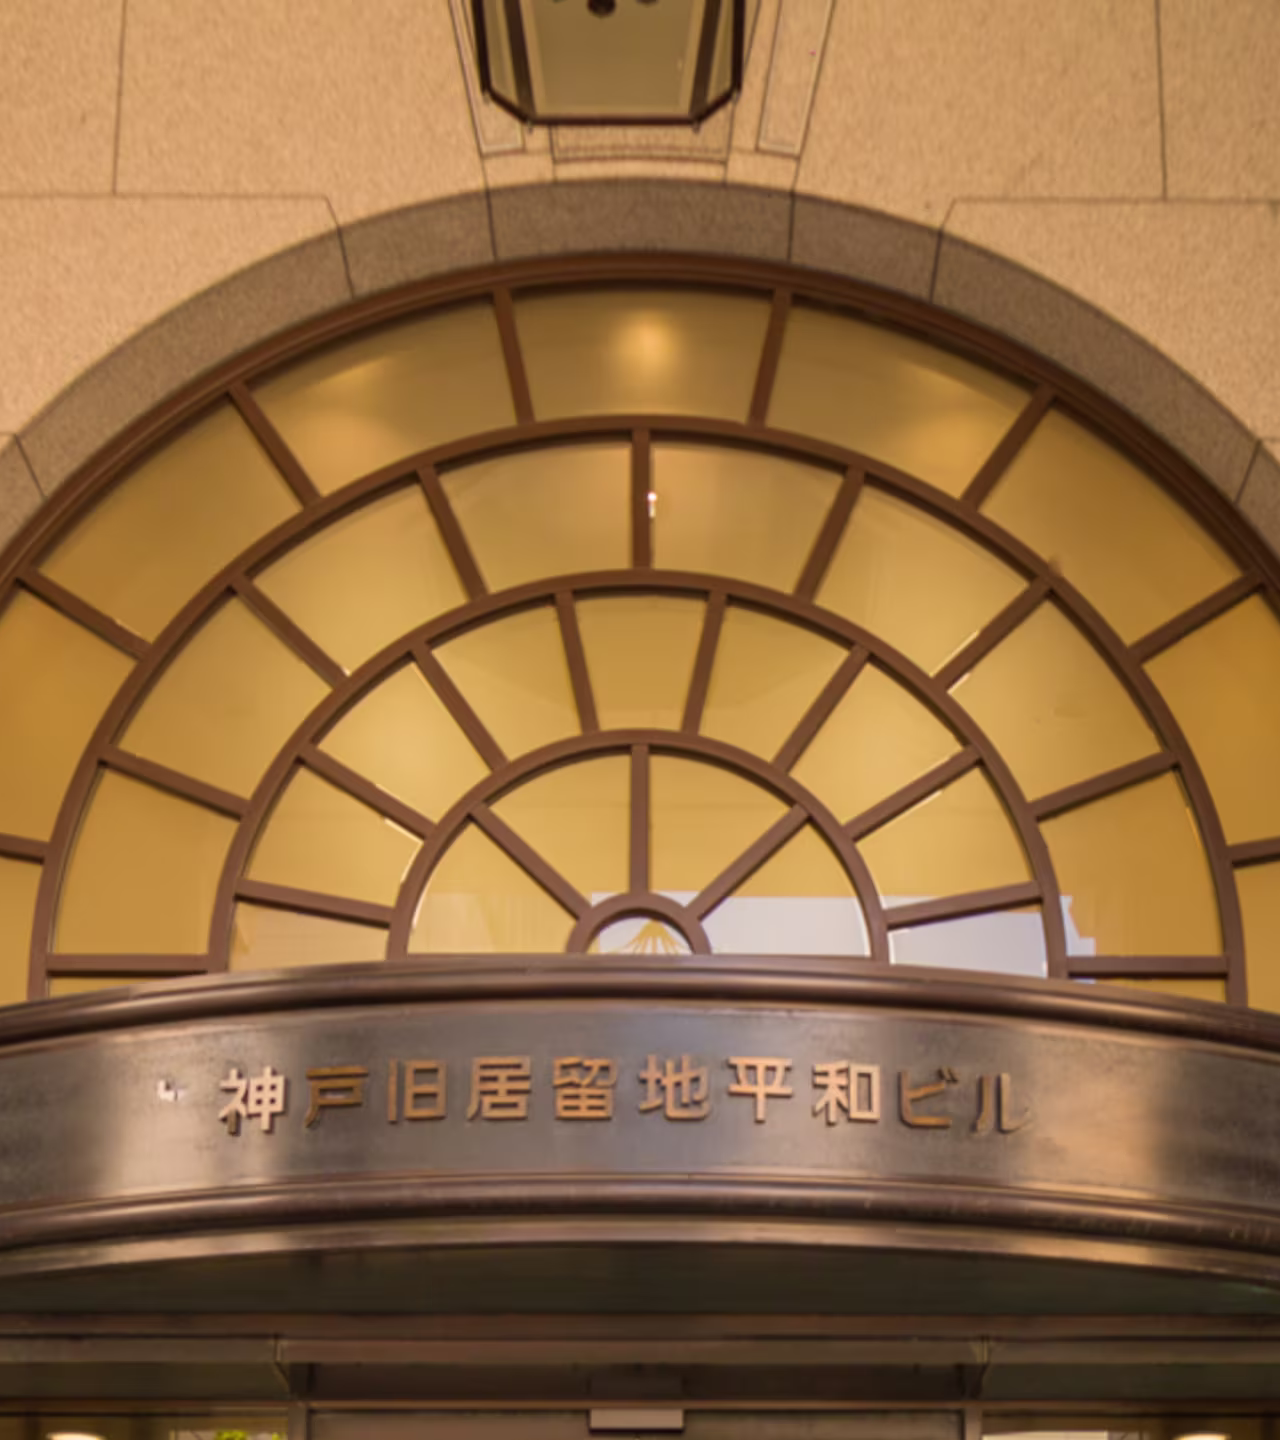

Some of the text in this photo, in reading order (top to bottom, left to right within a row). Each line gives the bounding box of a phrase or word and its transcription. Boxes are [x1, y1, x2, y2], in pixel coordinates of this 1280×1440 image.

[217, 1053, 1036, 1136] 神戸旧居留地平和ビル
